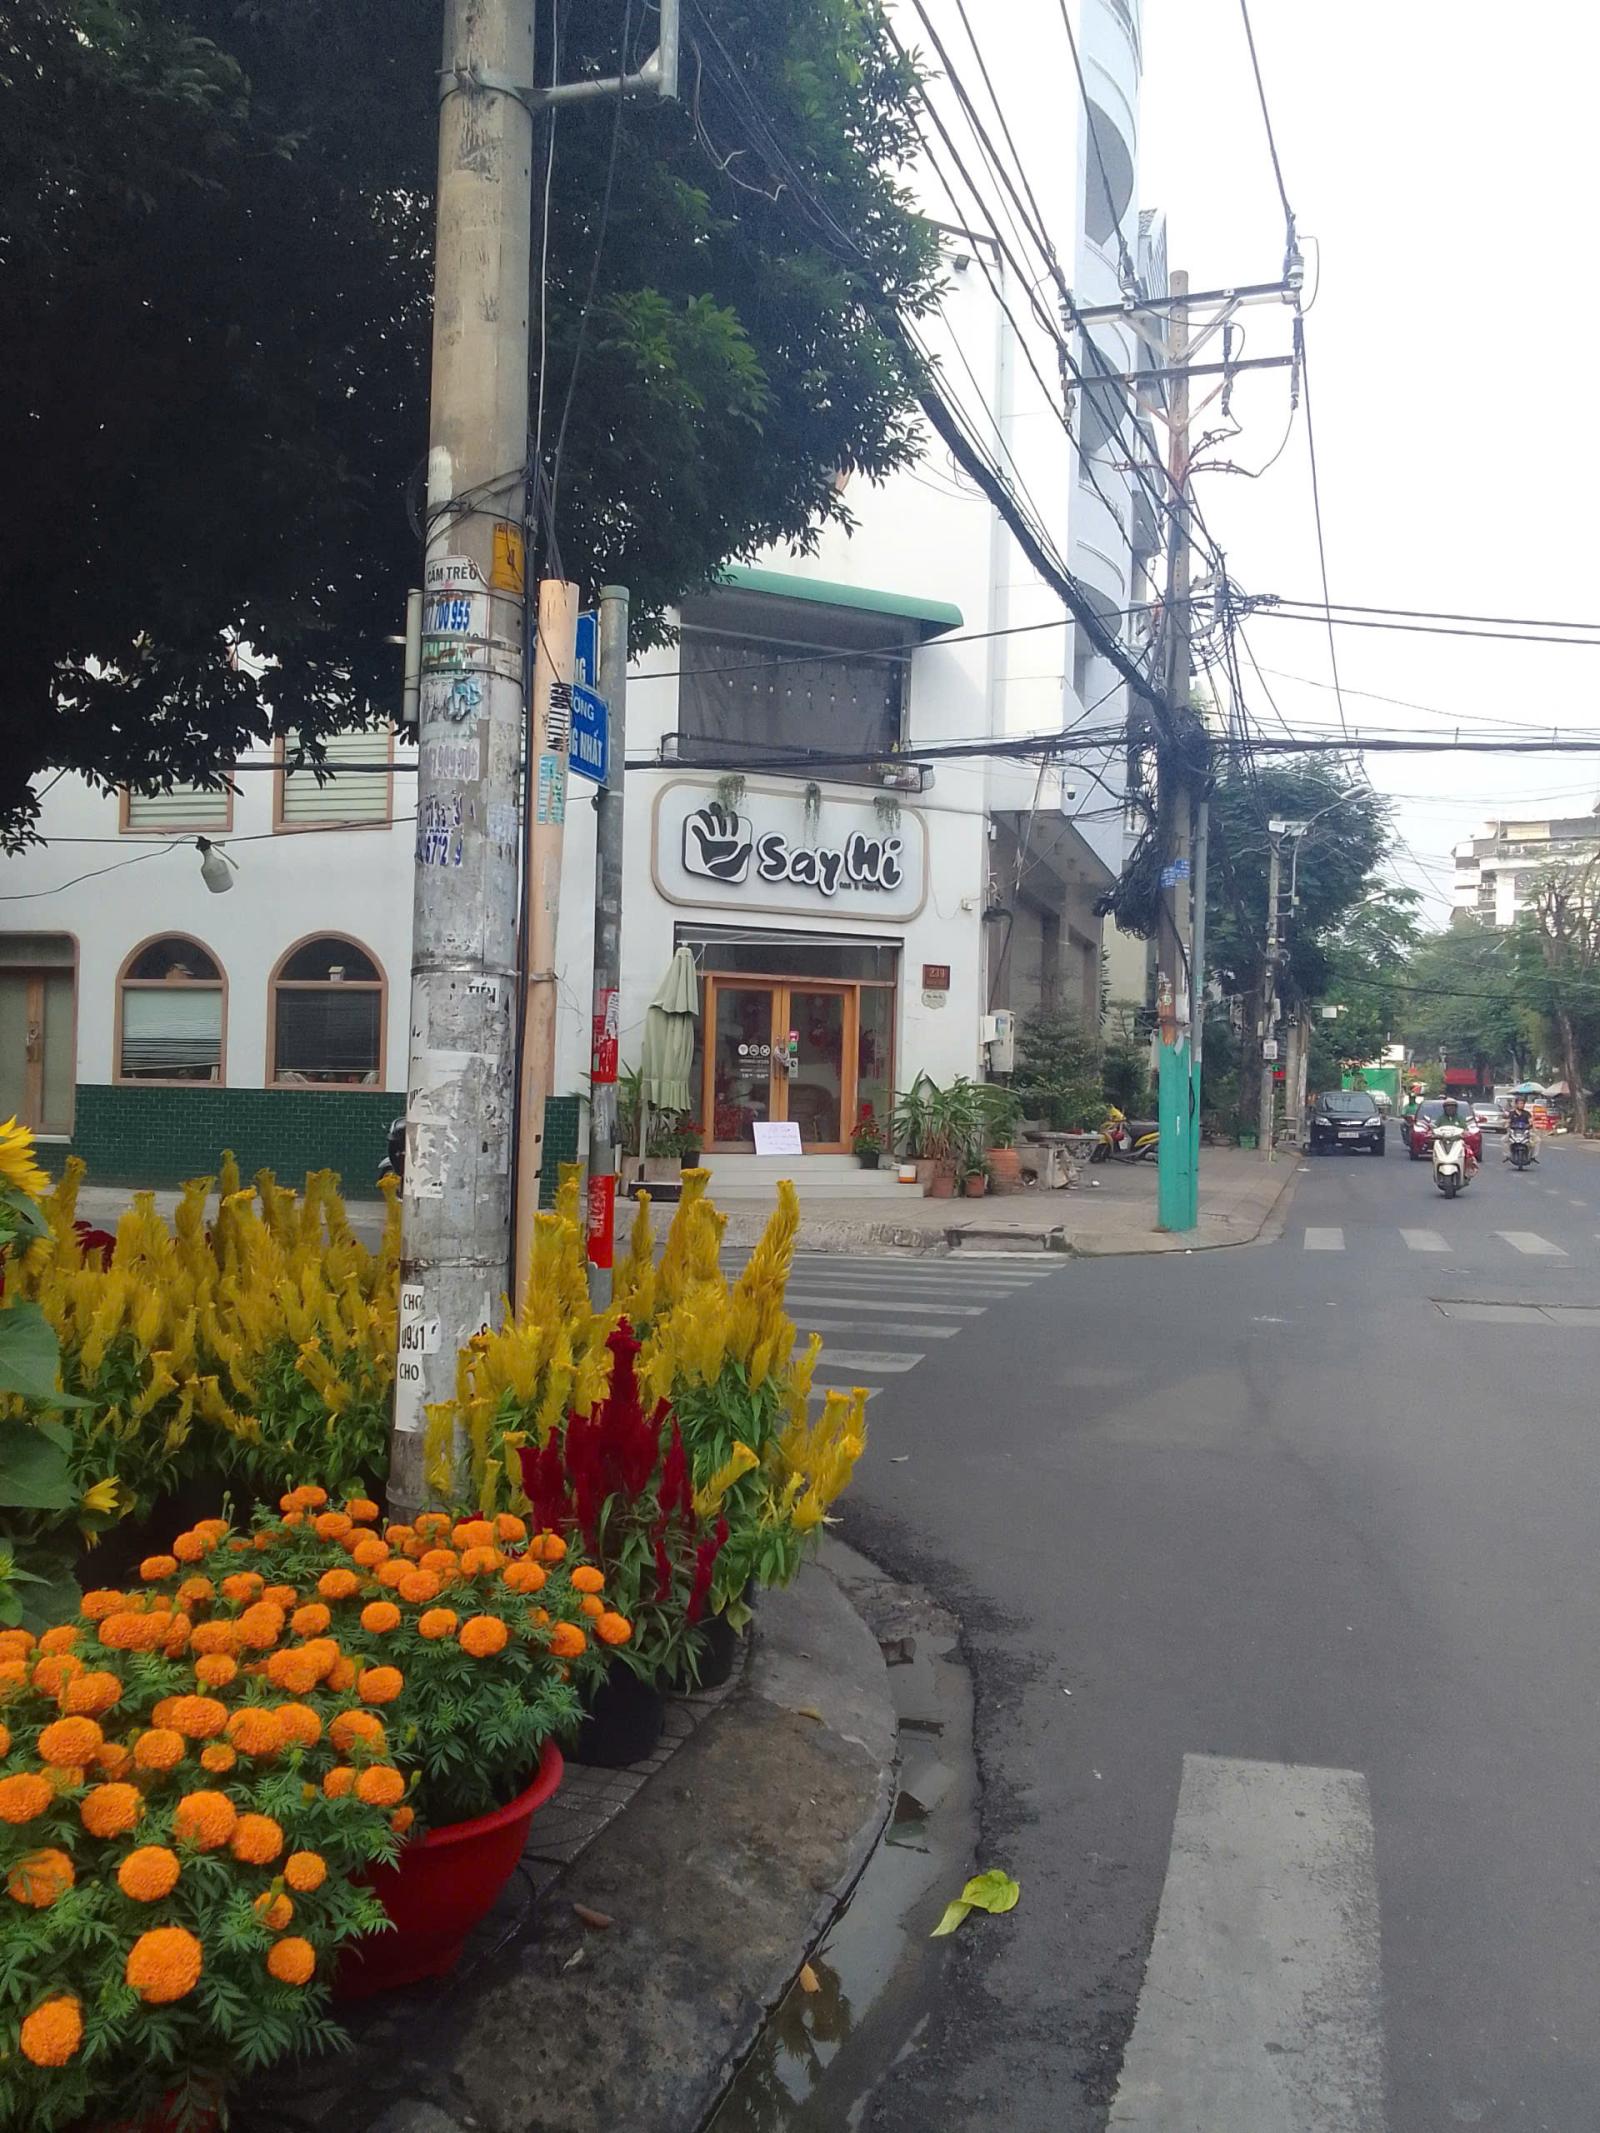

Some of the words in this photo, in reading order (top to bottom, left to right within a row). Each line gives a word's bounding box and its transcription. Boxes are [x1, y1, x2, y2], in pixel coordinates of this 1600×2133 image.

[451, 599, 471, 631] 955
[579, 728, 603, 769] NHẤT
[757, 831, 844, 896] Say
[399, 1362, 419, 1381] CHO
